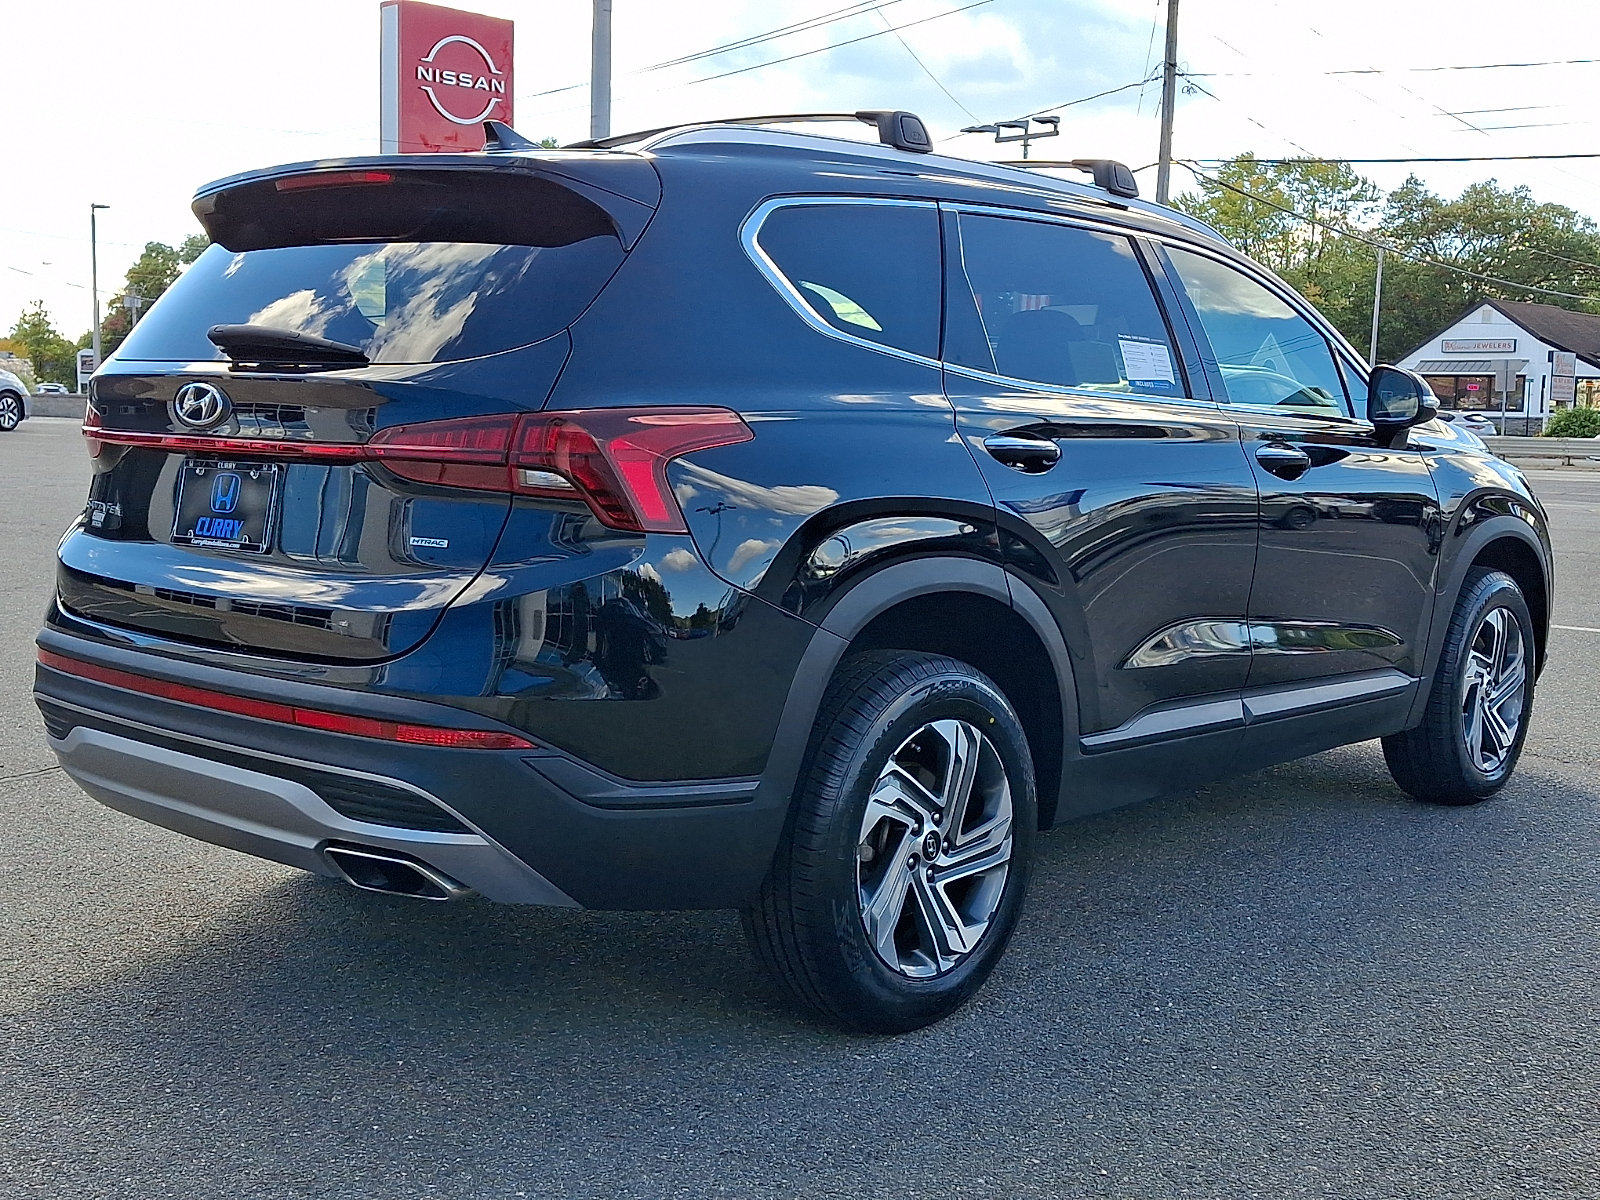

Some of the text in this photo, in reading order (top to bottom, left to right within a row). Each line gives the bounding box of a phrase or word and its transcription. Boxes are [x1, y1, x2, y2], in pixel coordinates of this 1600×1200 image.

[416, 65, 505, 93] NISSAN
[217, 462, 236, 470] CURRY
[195, 516, 245, 539] CURRY
[412, 538, 446, 546] HTRAC
